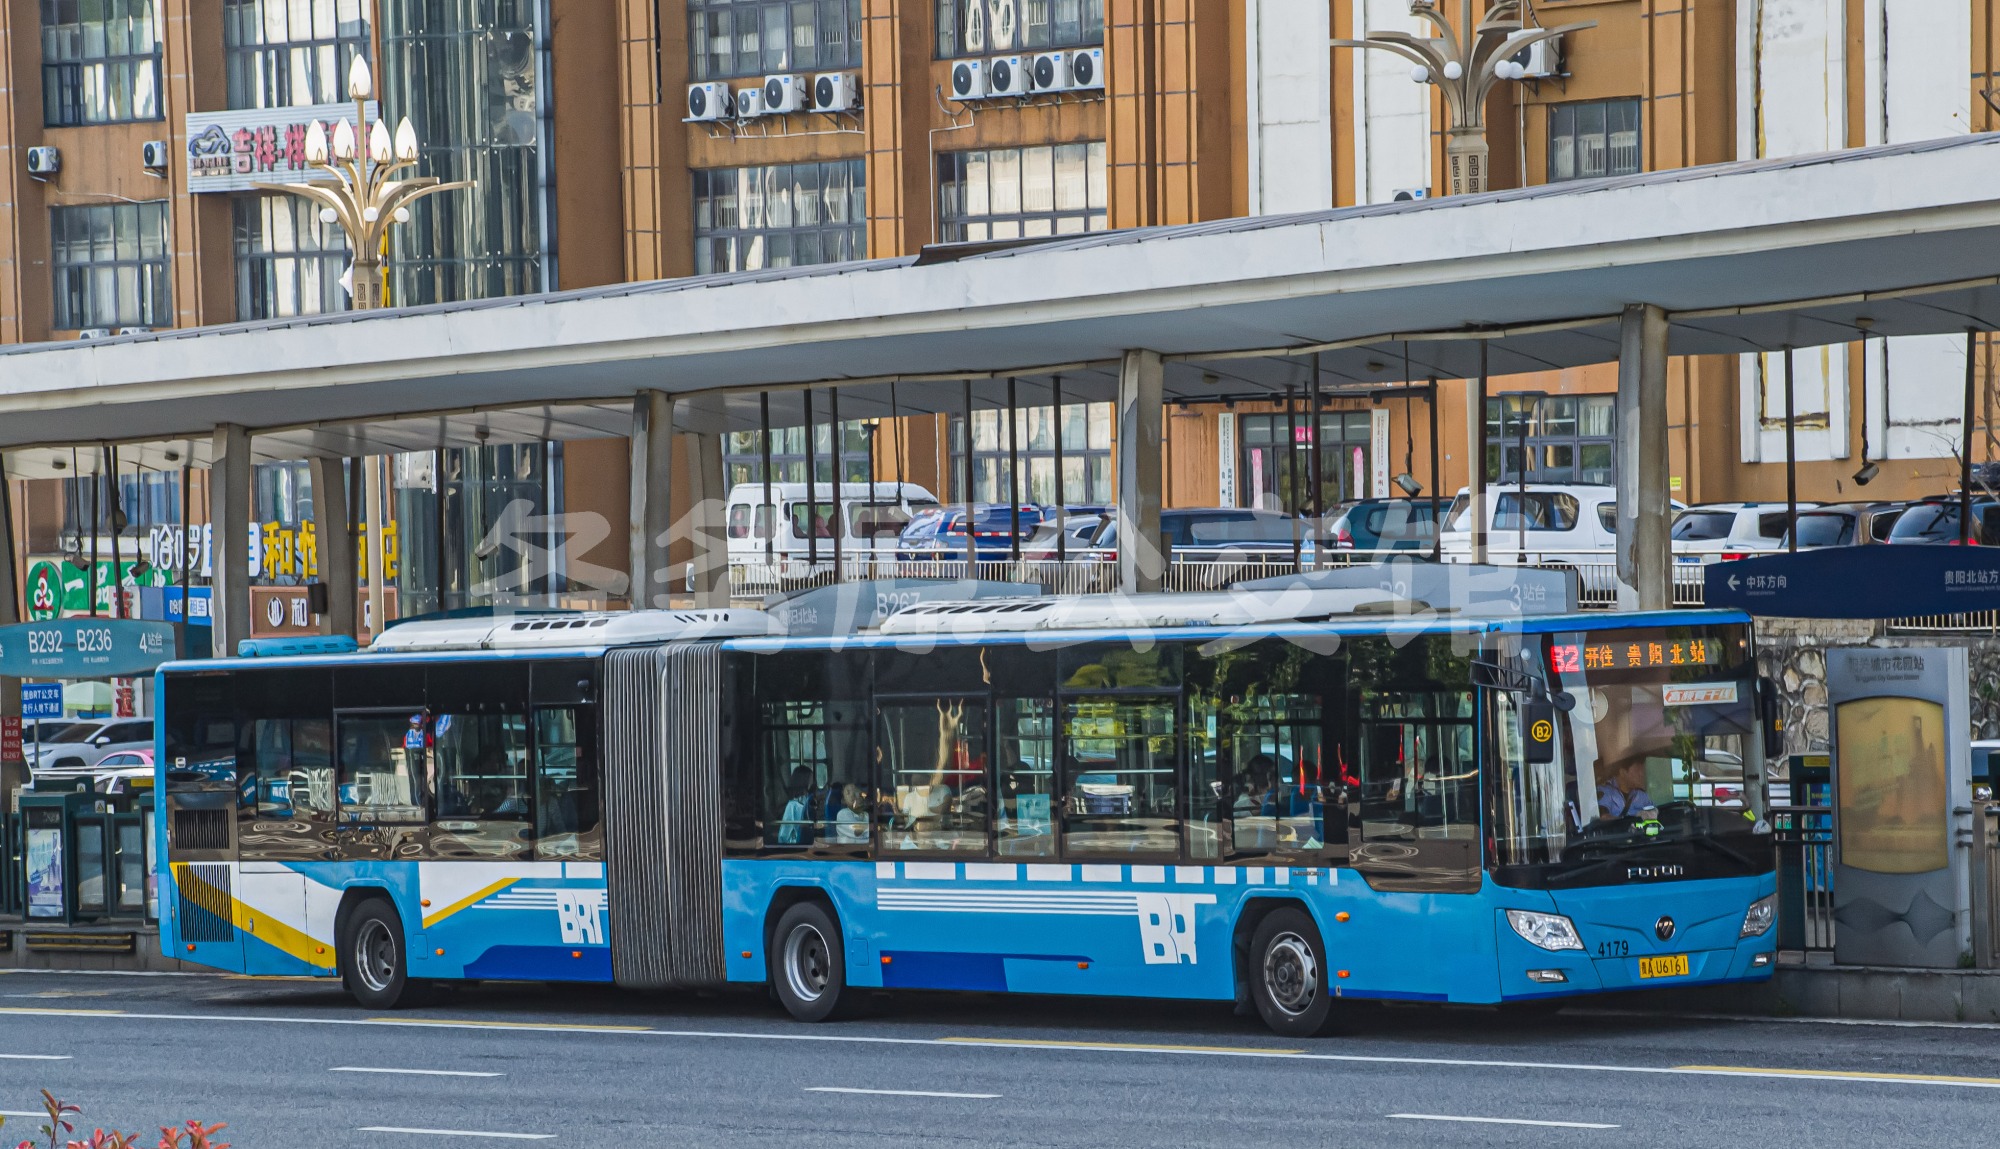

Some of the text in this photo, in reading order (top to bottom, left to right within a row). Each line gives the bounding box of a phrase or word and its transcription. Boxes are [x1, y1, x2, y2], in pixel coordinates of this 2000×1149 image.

[1746, 575, 1787, 589] 中环方向
[28, 630, 64, 654] B292
[76, 628, 113, 652] B236
[1551, 645, 1580, 673] B2
[1585, 644, 1614, 668] 开往
[1536, 725, 1551, 738] B2
[555, 889, 604, 944] BRT
[1597, 940, 1629, 957] 4179
